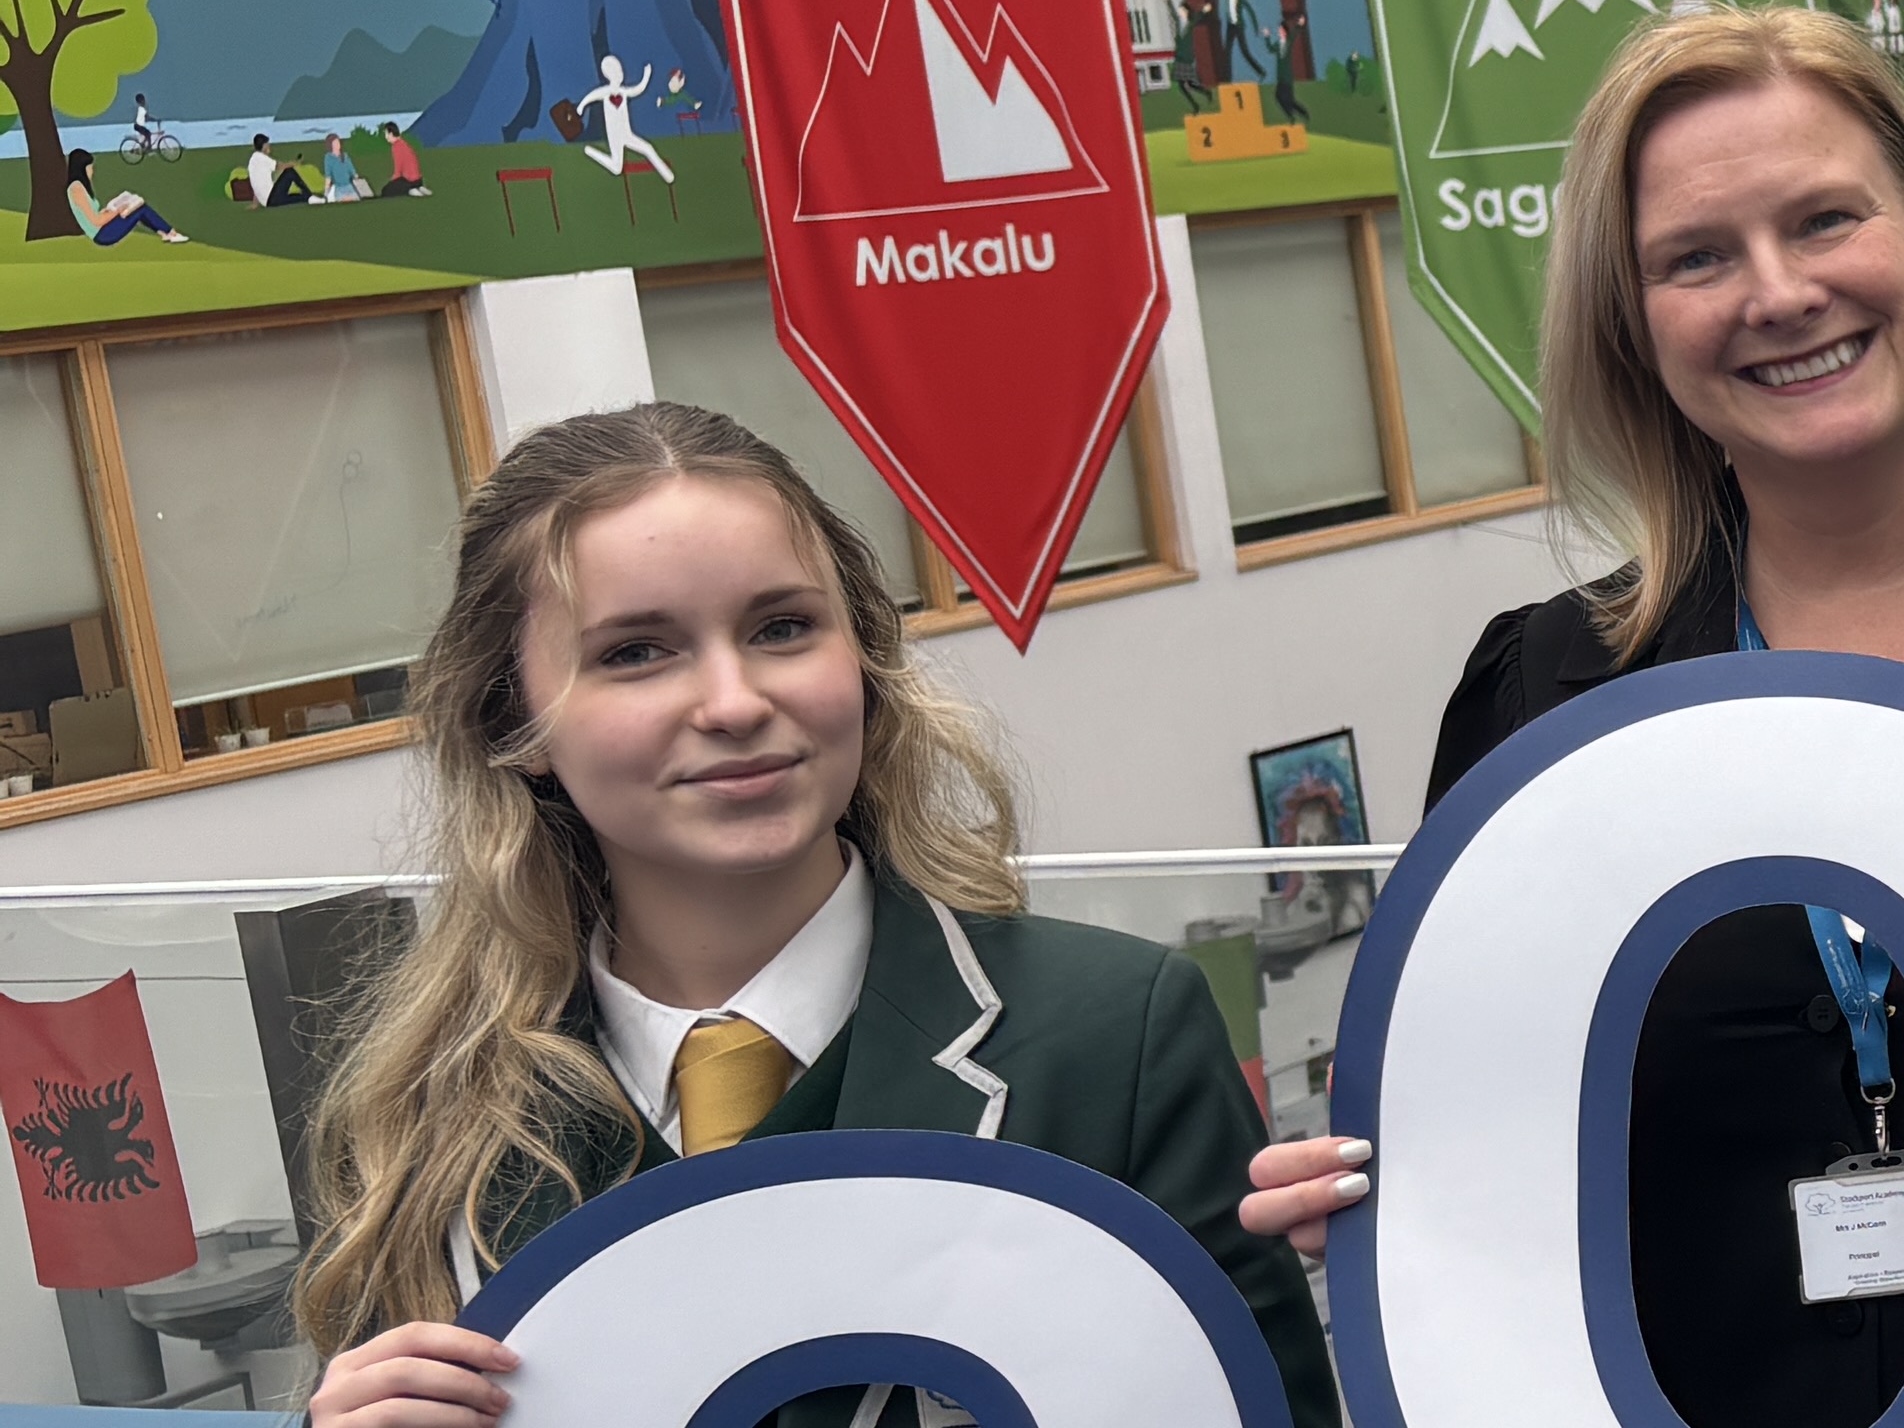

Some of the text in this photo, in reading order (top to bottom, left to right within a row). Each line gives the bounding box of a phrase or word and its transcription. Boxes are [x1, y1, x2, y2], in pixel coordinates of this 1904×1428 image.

[1235, 90, 1244, 110] 1
[1201, 126, 1213, 148] 2
[856, 222, 1056, 287] Makalu
